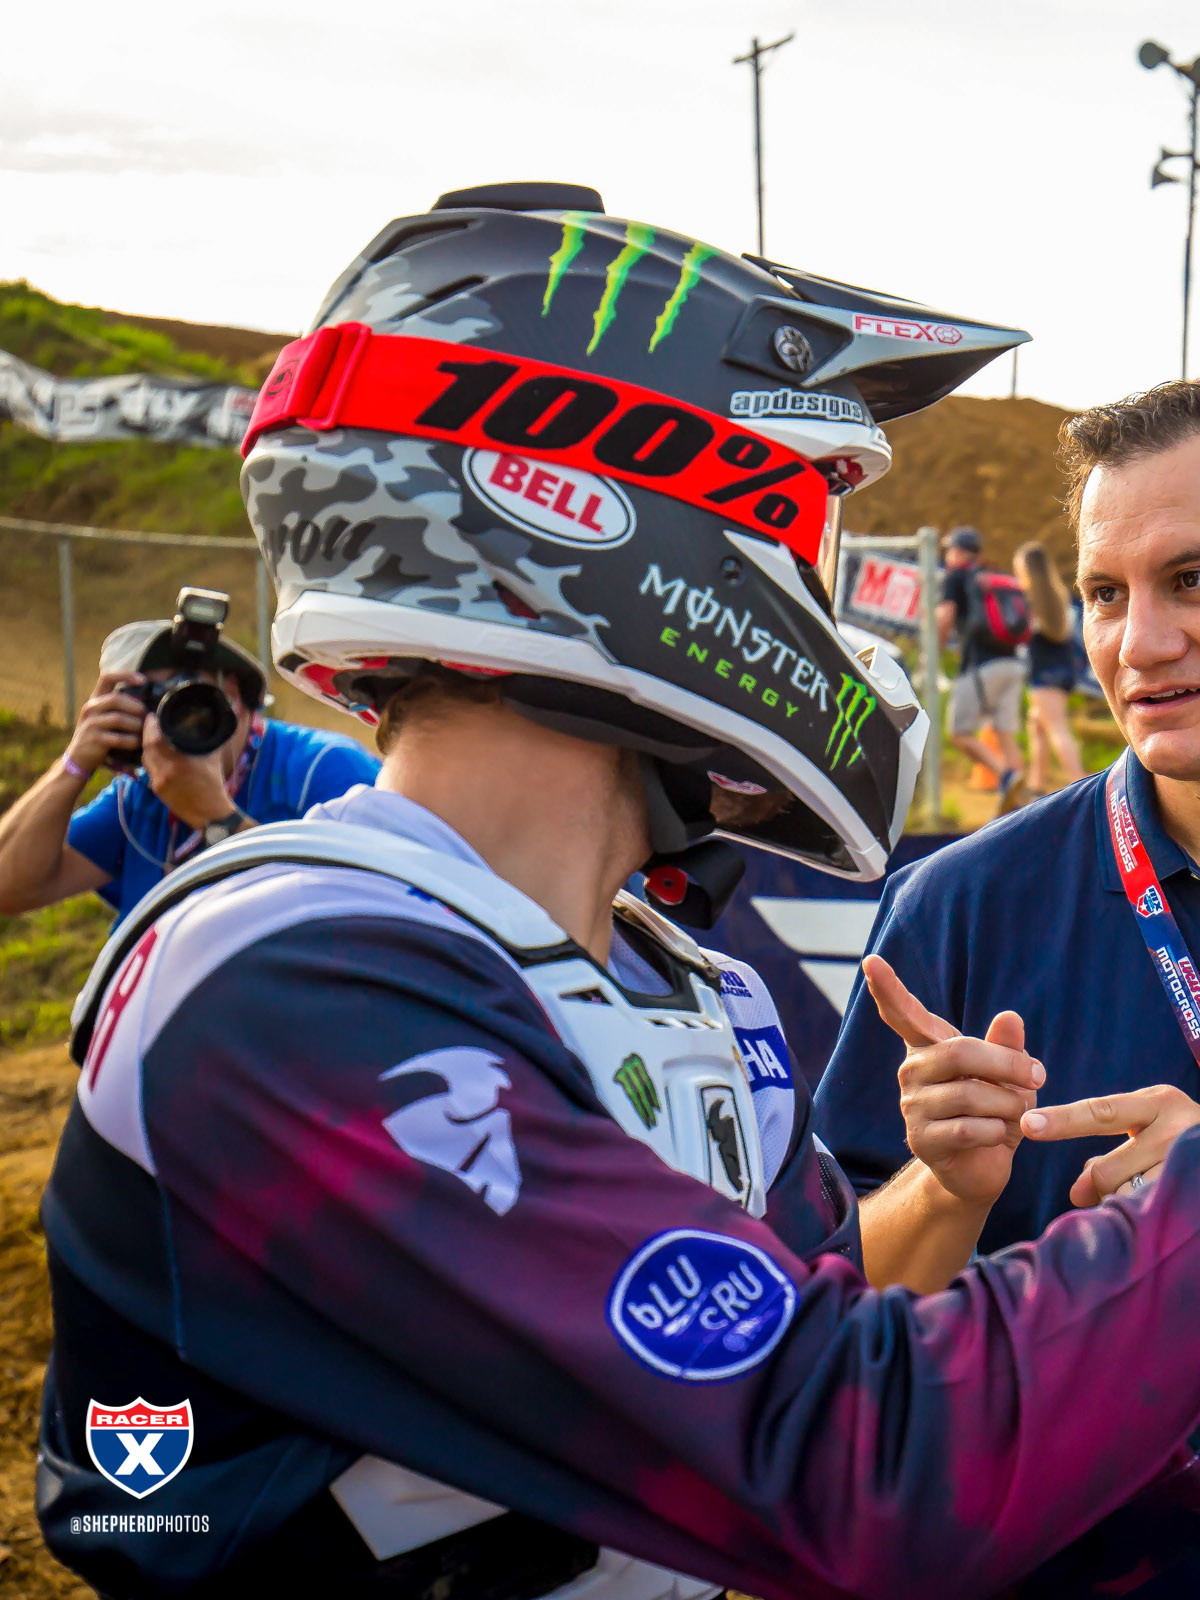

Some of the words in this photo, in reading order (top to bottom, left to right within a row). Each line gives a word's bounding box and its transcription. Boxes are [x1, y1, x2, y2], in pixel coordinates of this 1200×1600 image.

[855, 315, 934, 342] FLEX
[414, 360, 806, 529] 100%
[488, 454, 604, 534] BELL
[639, 563, 830, 712] MONSTER
[660, 627, 799, 718] ENERGY
[1109, 790, 1136, 873] MOTOCROSS
[1179, 959, 1200, 992] LUCAS
